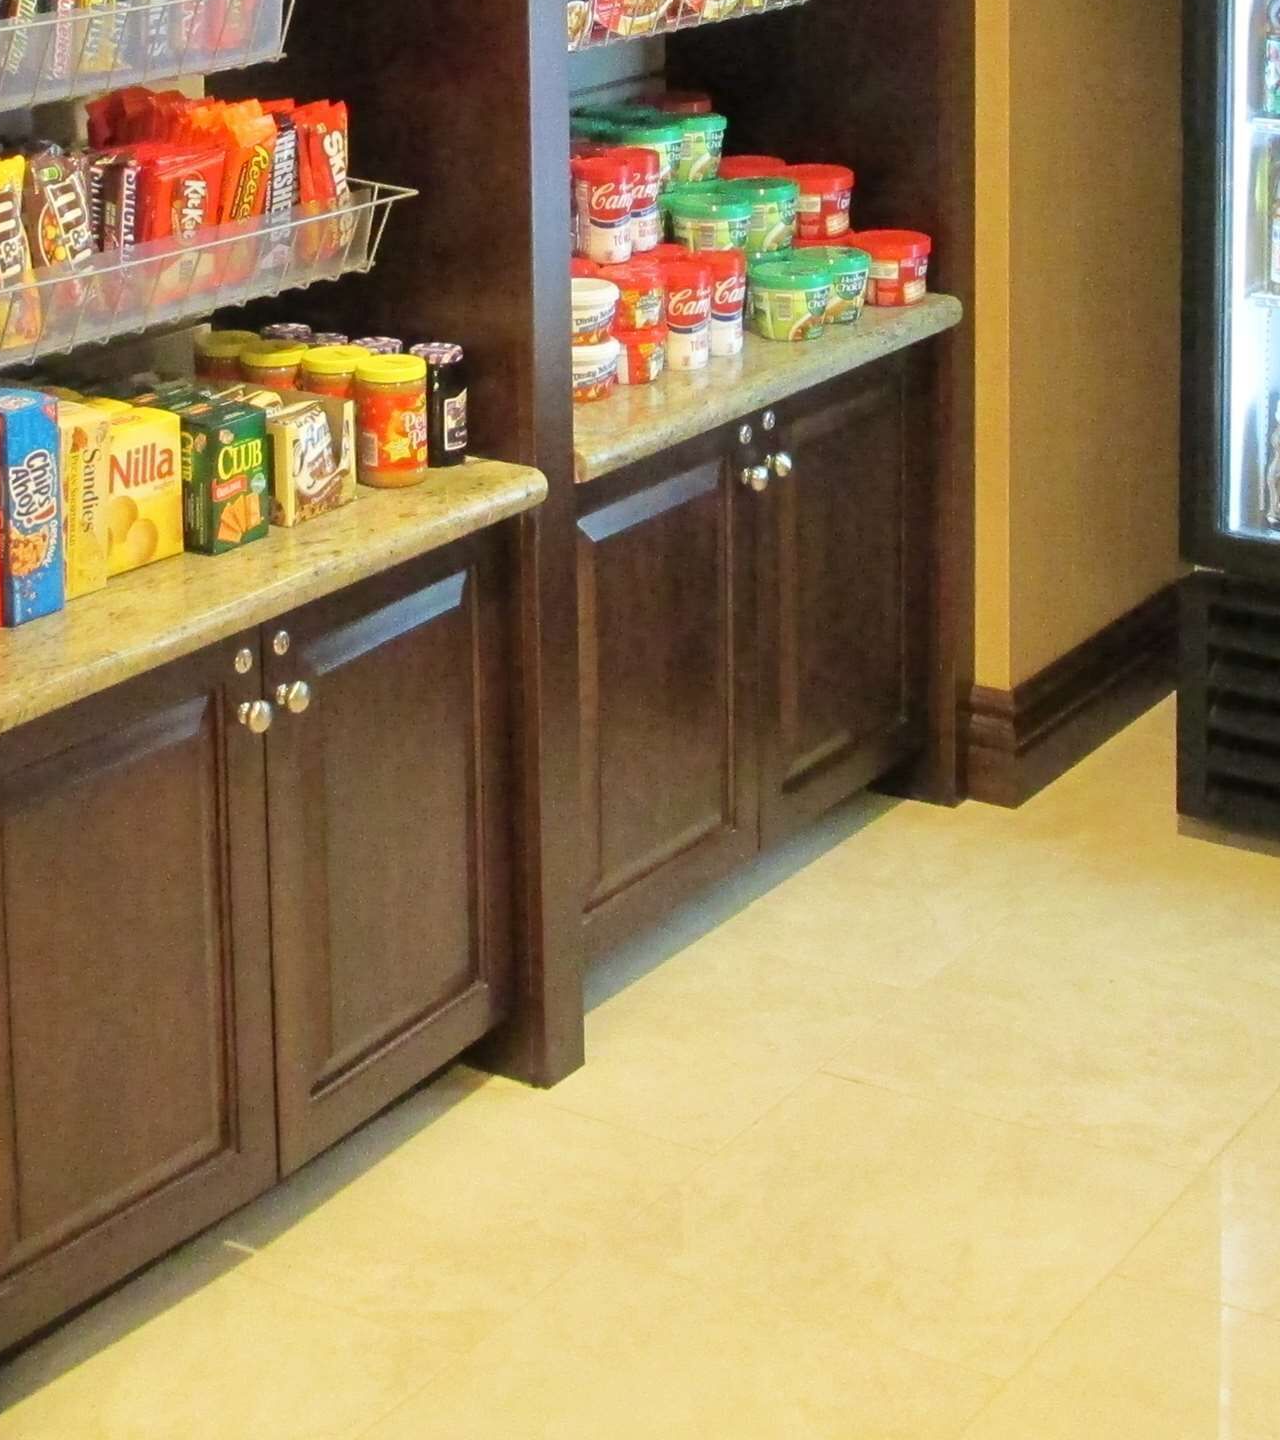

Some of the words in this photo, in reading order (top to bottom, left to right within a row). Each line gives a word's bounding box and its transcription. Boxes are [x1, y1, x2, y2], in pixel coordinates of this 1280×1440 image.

[235, 144, 270, 226] Reese's
[270, 128, 297, 243] HERSHEY'S
[575, 313, 599, 327] Dinty
[26, 450, 54, 509] Chips
[108, 442, 175, 494] Nilla
[218, 439, 262, 480] CLUB
[80, 447, 102, 534] Sandies
